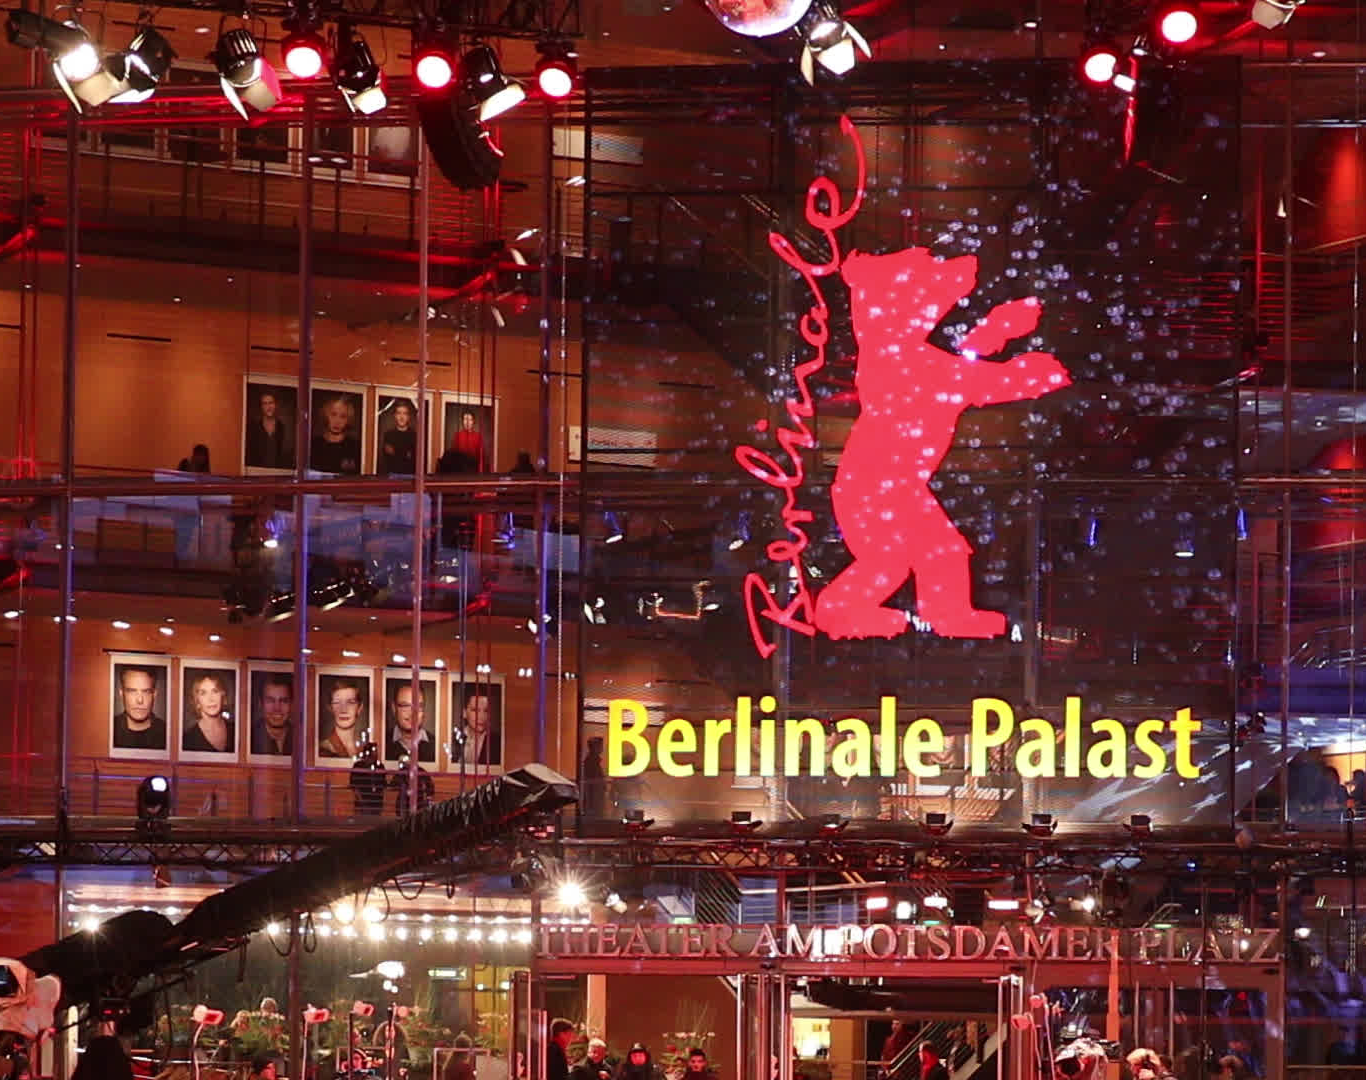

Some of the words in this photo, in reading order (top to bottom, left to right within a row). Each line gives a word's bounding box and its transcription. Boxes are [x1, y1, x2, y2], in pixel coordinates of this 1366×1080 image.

[734, 113, 866, 659] Berlinale
[607, 695, 943, 778] Berlinale
[970, 695, 1203, 778] Palast
[537, 922, 737, 958] THEATER
[749, 922, 825, 961] AM
[839, 923, 1121, 960] POTSDAMER
[1137, 926, 1281, 962] PLATZ
